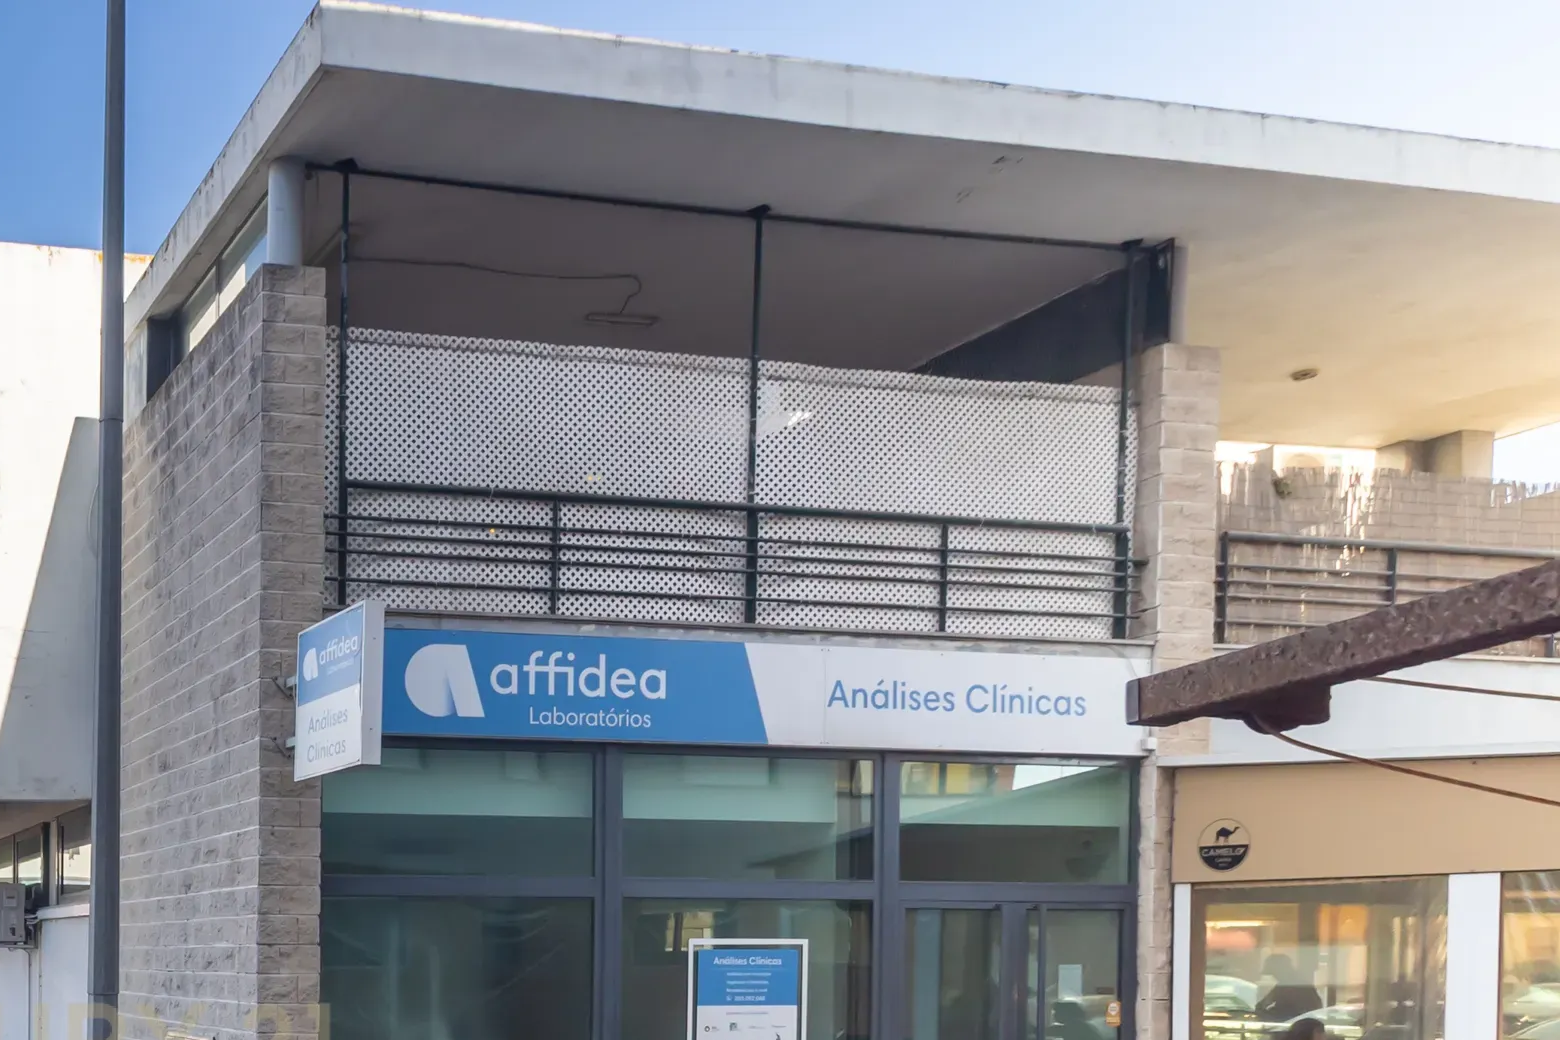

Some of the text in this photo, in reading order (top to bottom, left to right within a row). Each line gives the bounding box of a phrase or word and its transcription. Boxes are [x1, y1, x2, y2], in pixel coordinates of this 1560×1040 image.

[319, 635, 358, 665] affidea
[490, 650, 667, 700] affidea
[827, 679, 1087, 717] Análises Clínicas
[308, 708, 348, 734] Análises
[529, 706, 652, 728] Laboratórios
[307, 738, 346, 762] Clínicas
[713, 955, 782, 966] Análises Clínicas
